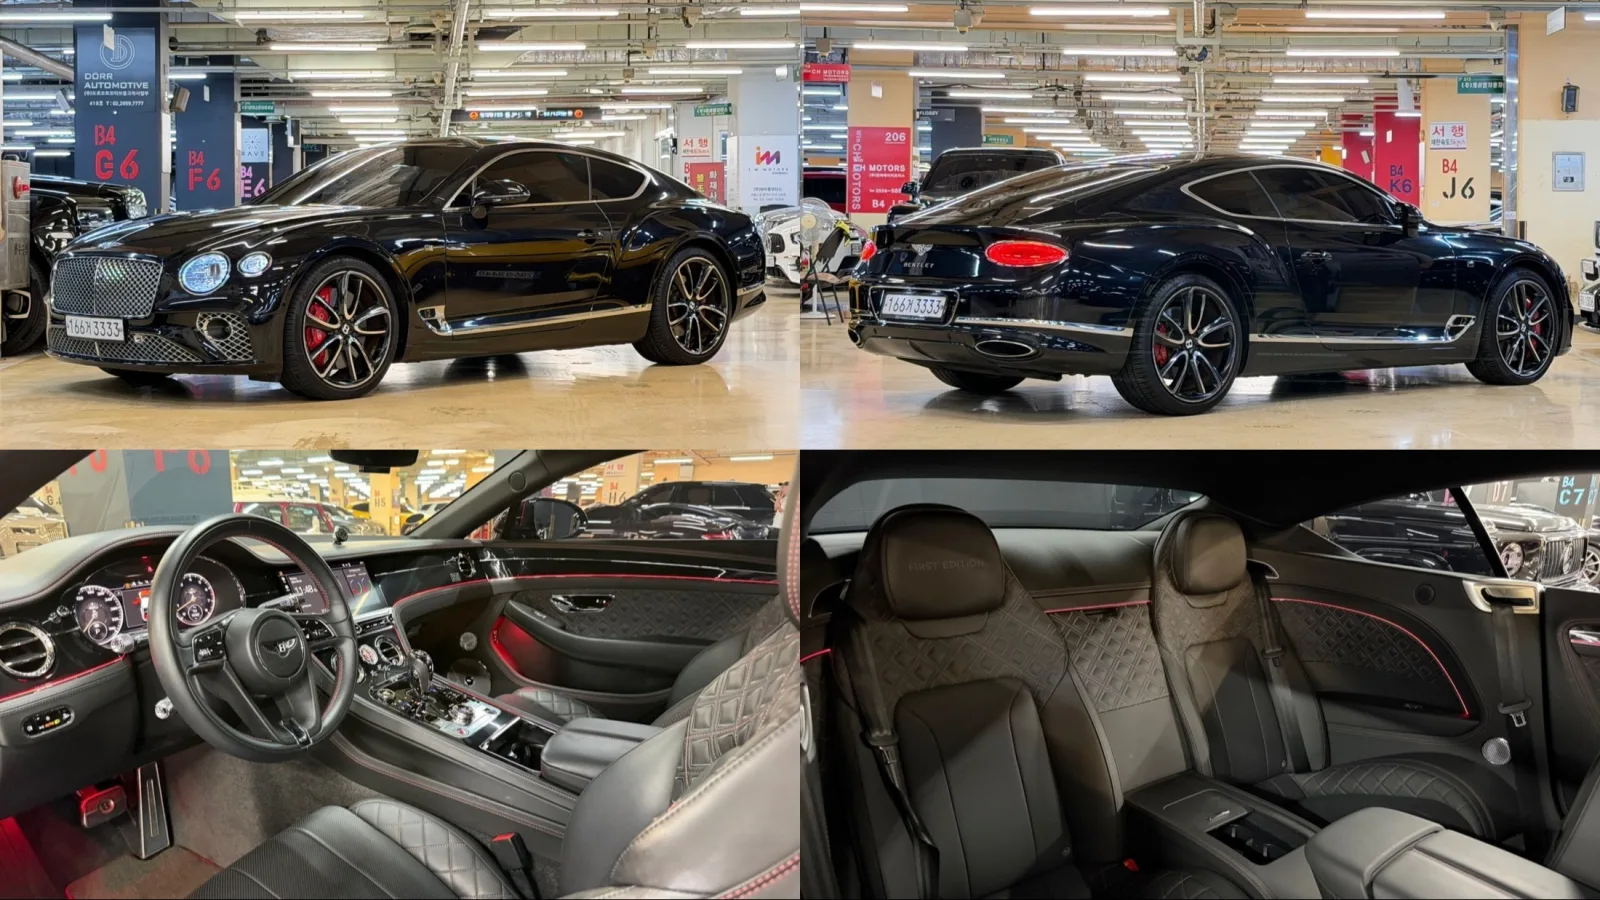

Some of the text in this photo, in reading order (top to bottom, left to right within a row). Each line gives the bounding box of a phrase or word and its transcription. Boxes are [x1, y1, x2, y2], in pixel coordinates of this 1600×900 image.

[84, 81, 149, 89] AUTOMOTIVE
[94, 125, 117, 146] B4
[885, 132, 907, 142] 206
[187, 151, 204, 166] B4
[869, 164, 906, 172] MOTORS
[1389, 165, 1404, 177] B4
[1442, 158, 1458, 174] B4
[1390, 178, 1413, 194] K6
[872, 199, 886, 208] B4
[1562, 476, 1576, 488] B4
[1559, 488, 1586, 506] C7
